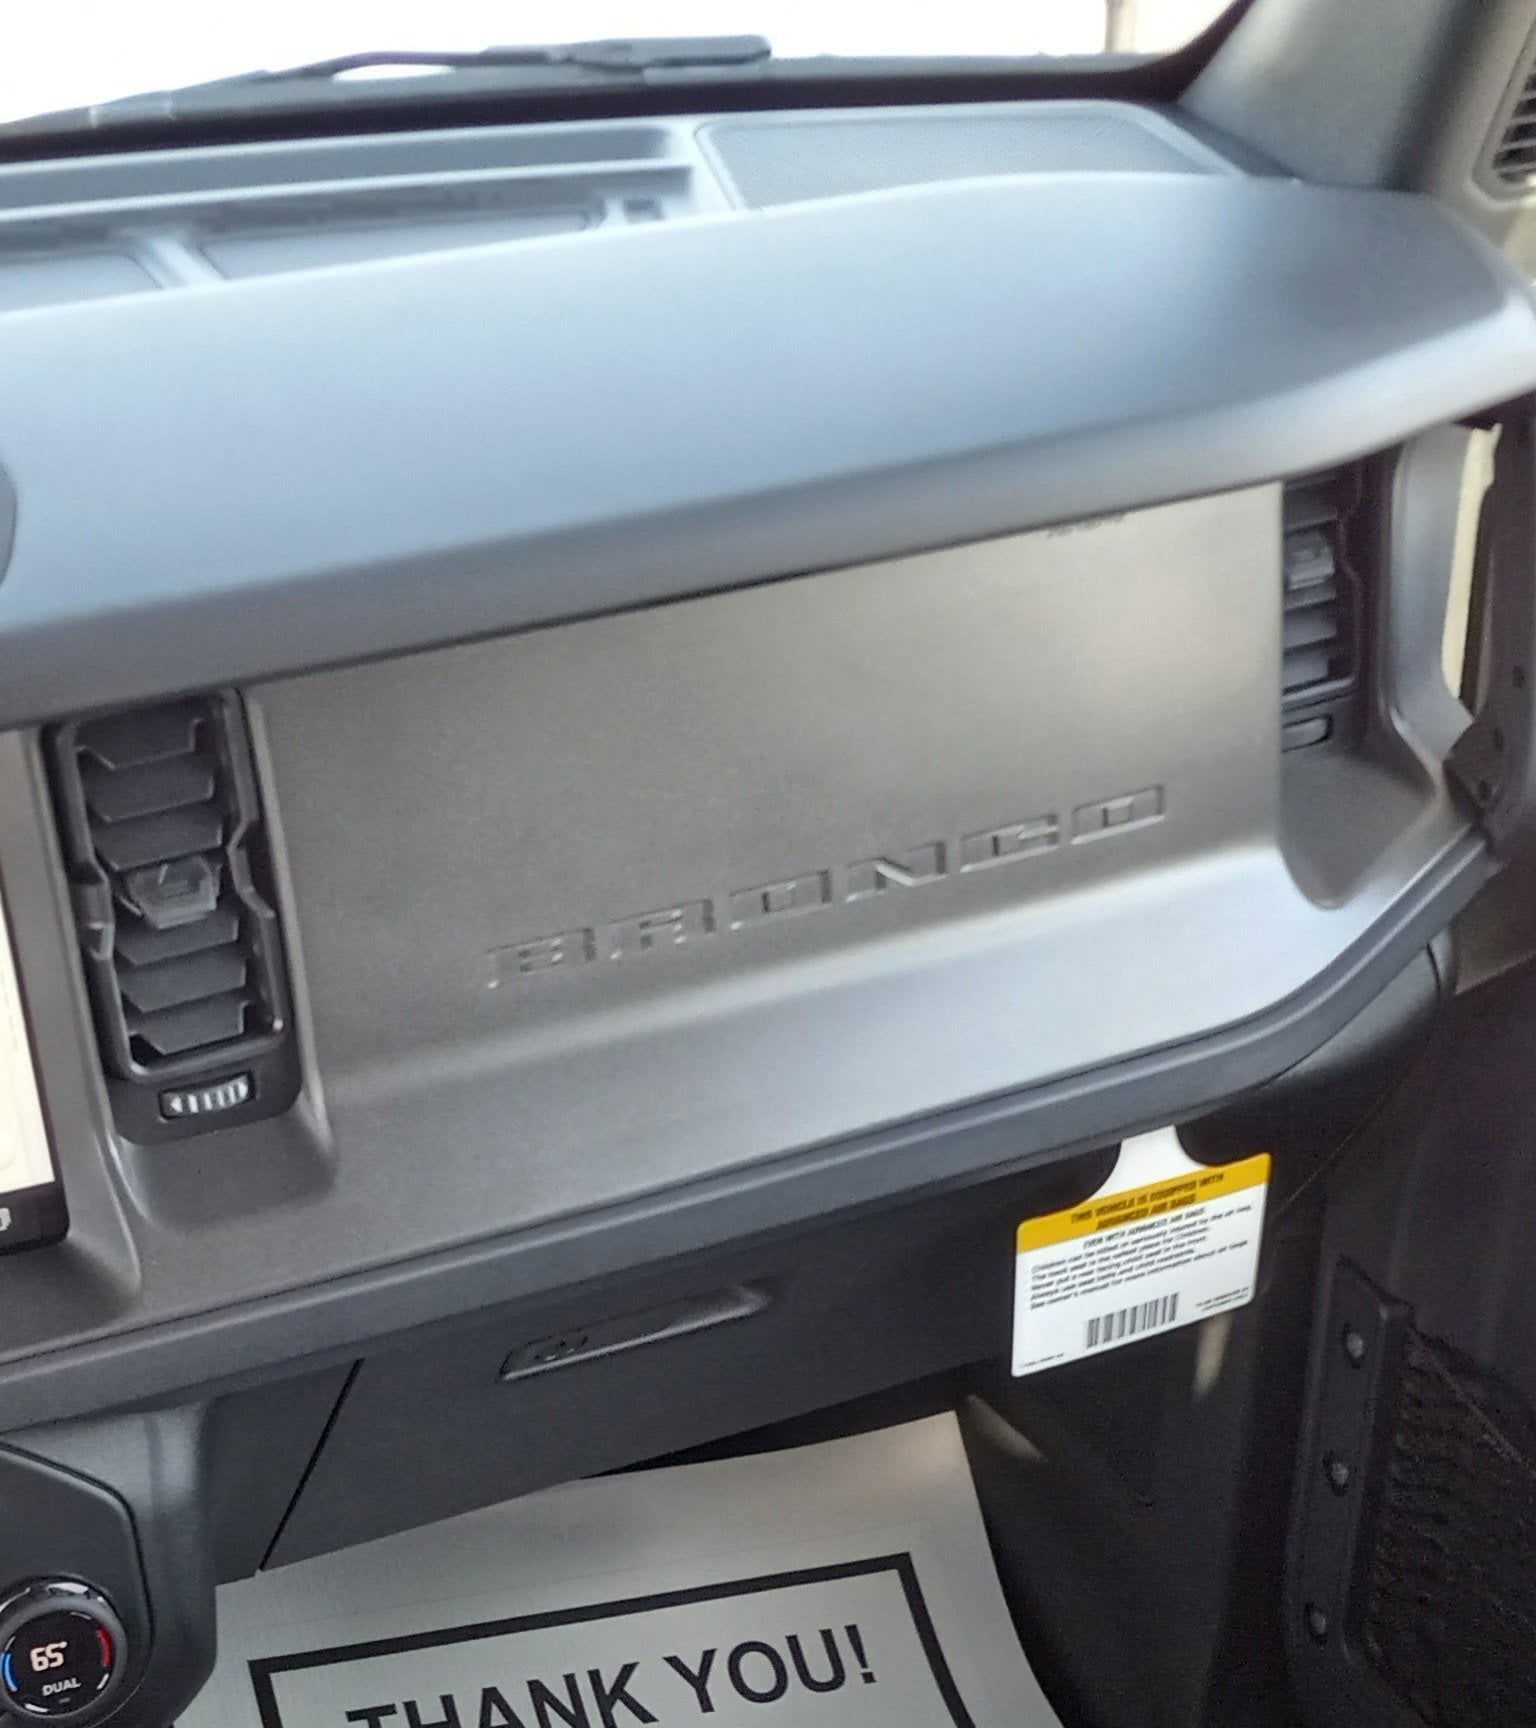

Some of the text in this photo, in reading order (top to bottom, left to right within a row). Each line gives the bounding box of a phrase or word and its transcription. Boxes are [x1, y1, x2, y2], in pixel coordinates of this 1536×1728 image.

[485, 784, 1166, 989] BRONCO
[42, 1677, 82, 1697] DUAL
[664, 1623, 877, 1714] YOU!
